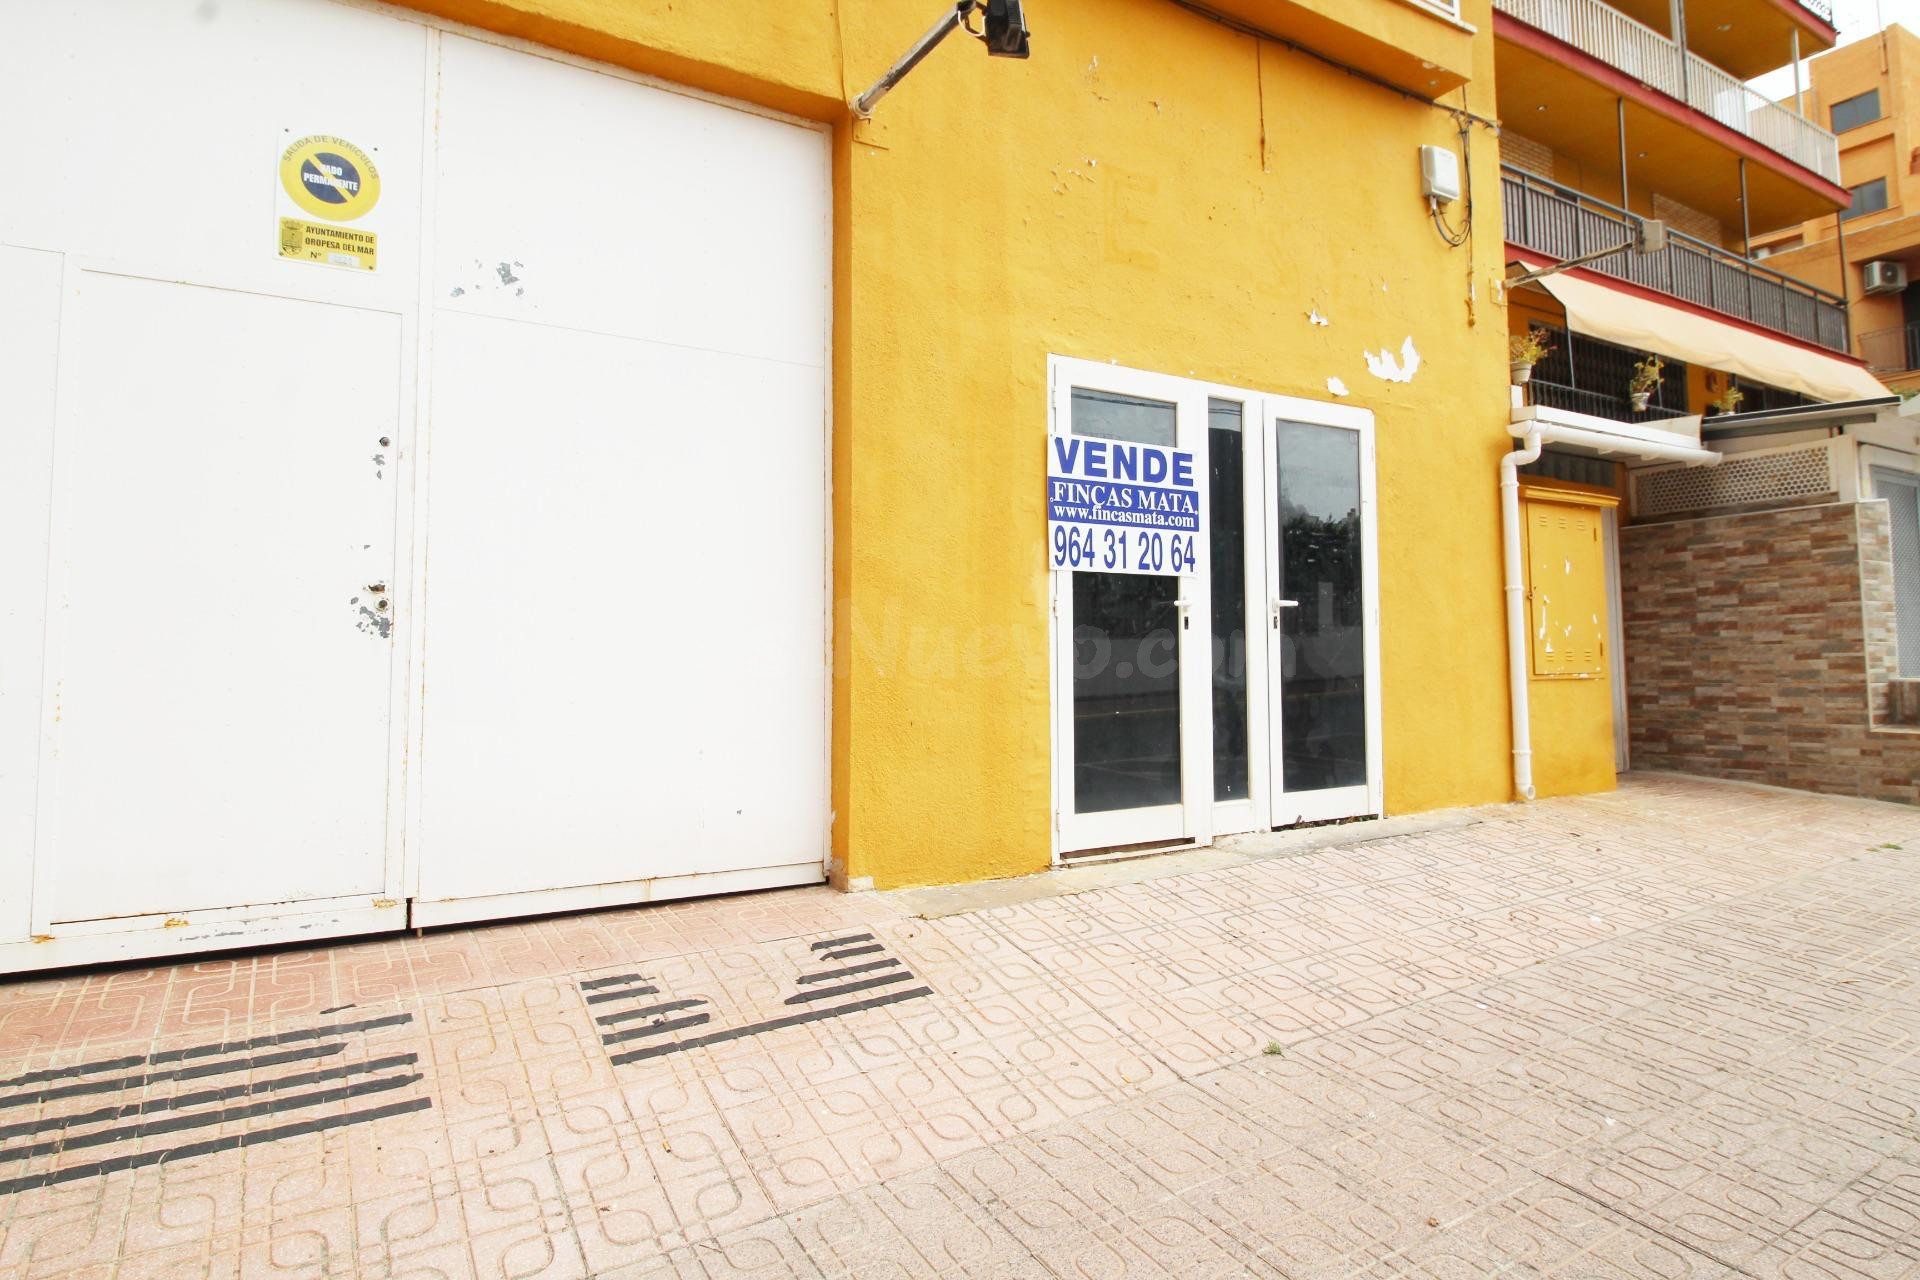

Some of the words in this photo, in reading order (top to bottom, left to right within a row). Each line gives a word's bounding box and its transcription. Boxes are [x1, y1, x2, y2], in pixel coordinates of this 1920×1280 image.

[283, 137, 311, 161] SALIDA
[314, 135, 328, 143] DE
[332, 136, 379, 179] VEHICULOS
[305, 238, 340, 249] OROPESA
[343, 243, 355, 252] DEL
[357, 245, 374, 255] MAR
[306, 226, 364, 242] AYUNTAMIENTO
[365, 235, 374, 244] DE
[1054, 437, 1194, 486] VENDE
[1054, 505, 1194, 527] www.fincasmata.com
[1054, 525, 1095, 567] 964
[1104, 529, 1127, 569] 31
[1138, 532, 1163, 571] 20
[1171, 534, 1195, 573] 64
